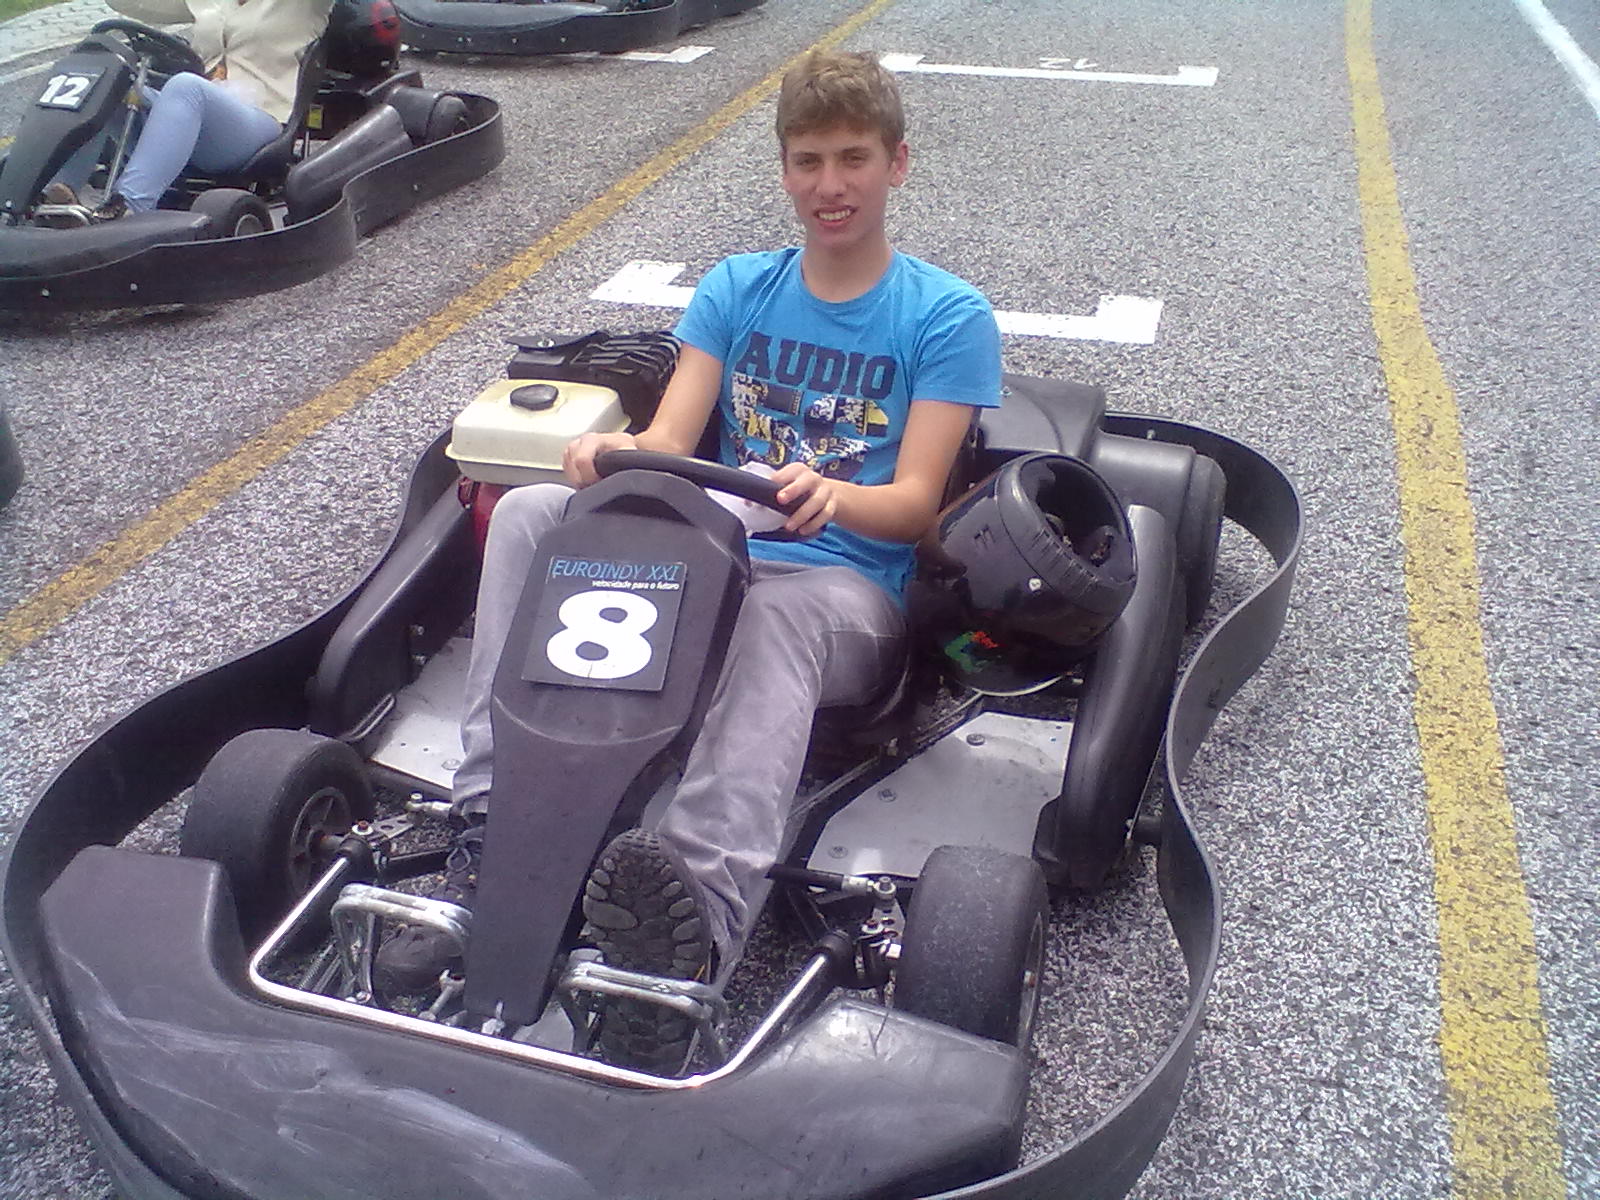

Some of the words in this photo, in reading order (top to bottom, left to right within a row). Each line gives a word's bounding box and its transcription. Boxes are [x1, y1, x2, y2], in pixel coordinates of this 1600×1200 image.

[40, 75, 89, 105] 12
[734, 331, 897, 399] AUDIO
[552, 560, 644, 580] EUROINDY
[646, 565, 680, 581] XXI
[631, 582, 650, 590] para
[547, 590, 658, 679] 8
